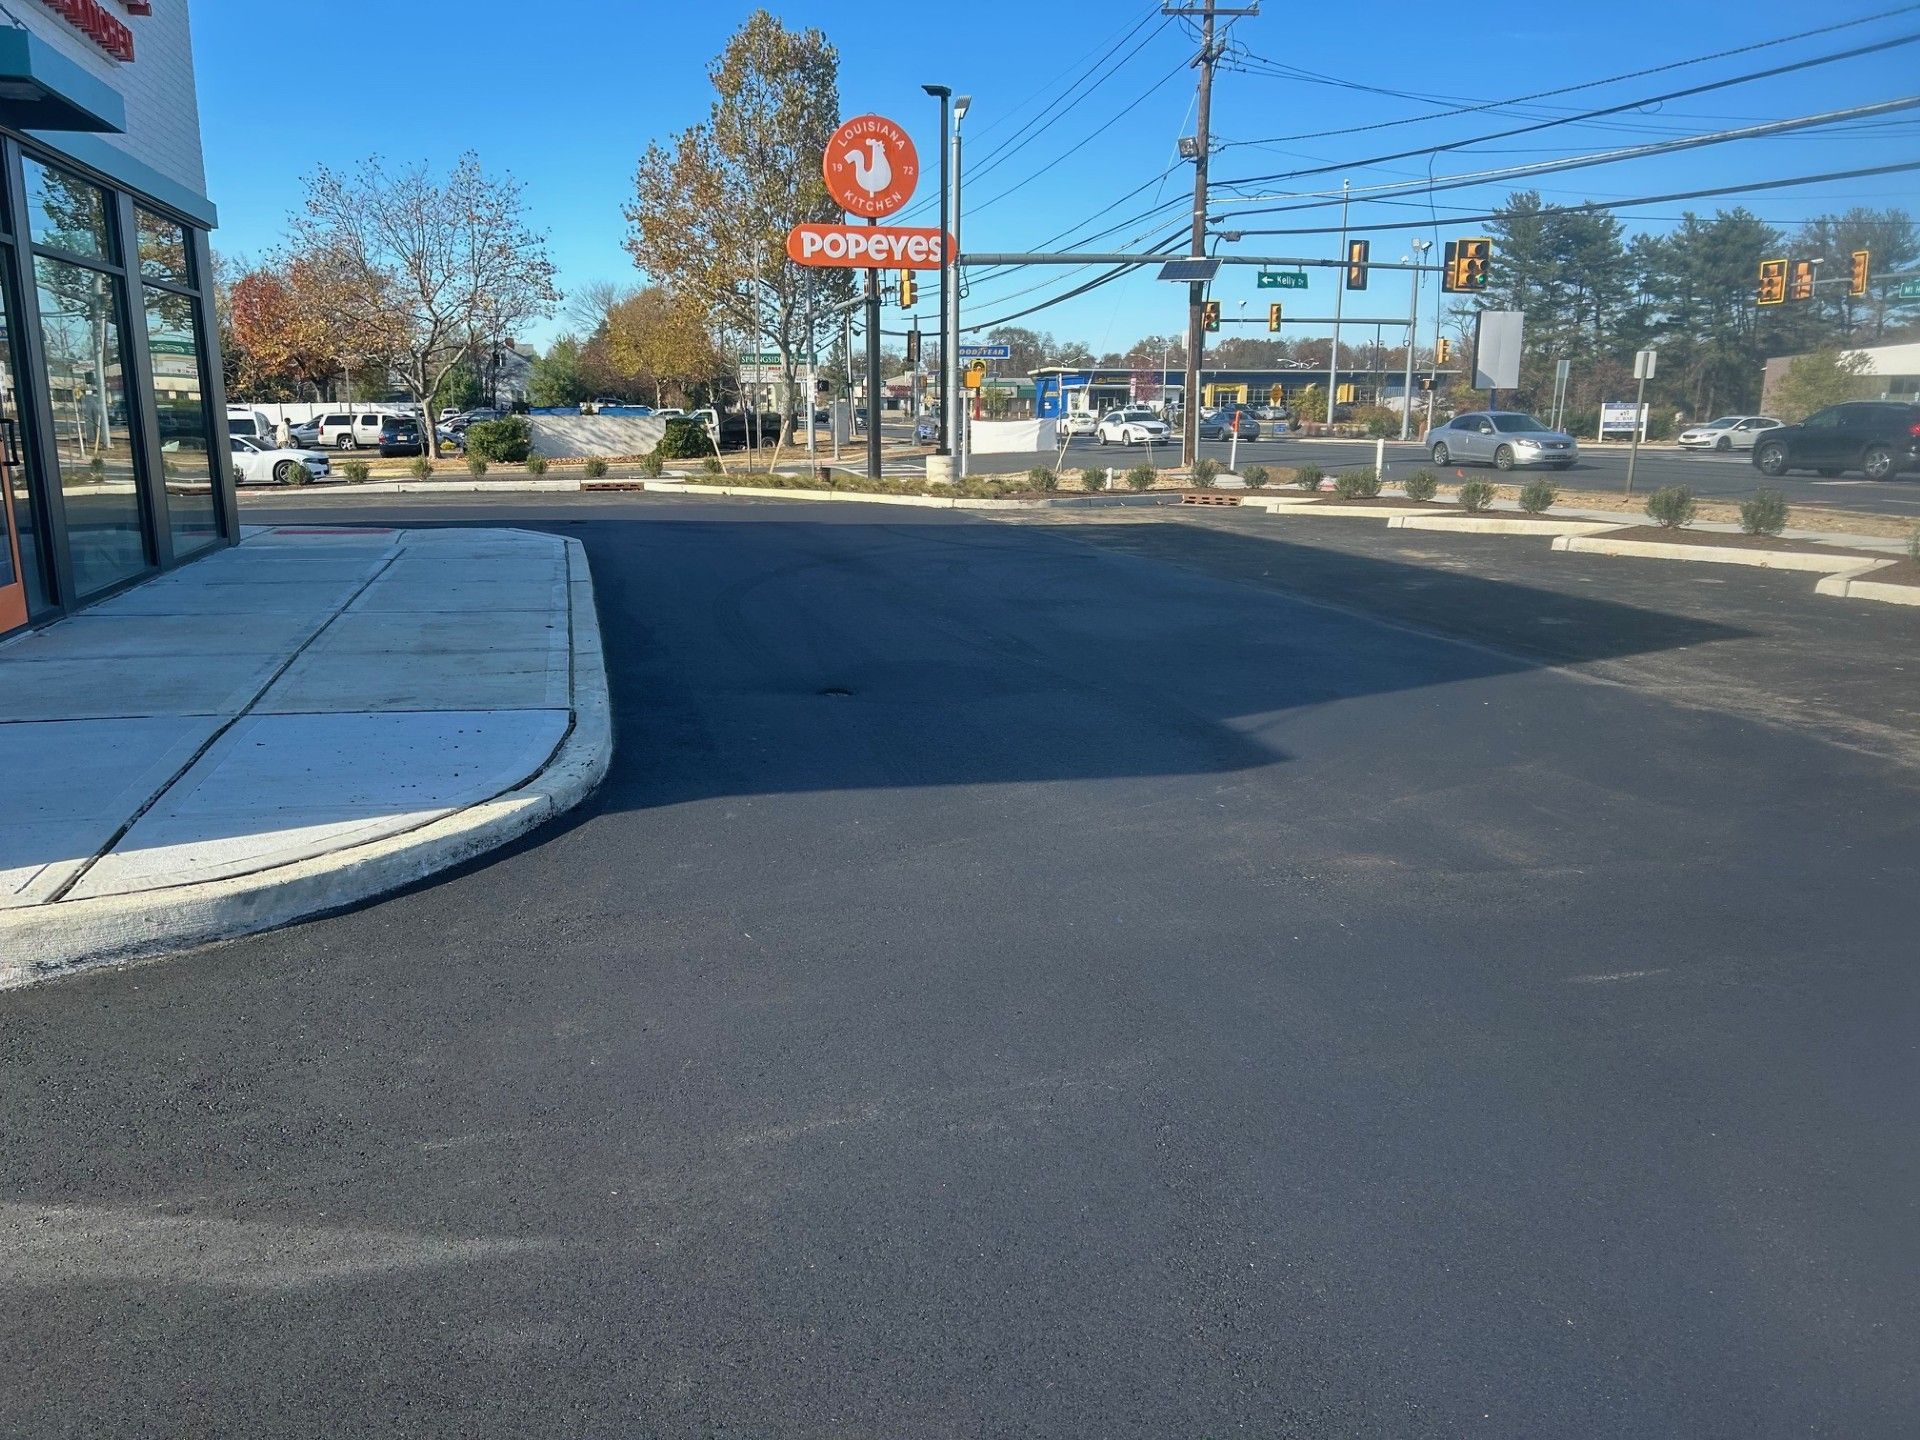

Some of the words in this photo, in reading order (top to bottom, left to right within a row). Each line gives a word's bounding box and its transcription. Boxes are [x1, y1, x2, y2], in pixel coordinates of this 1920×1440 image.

[837, 121, 905, 151] LOUISIANA
[832, 163, 843, 173] 19
[903, 165, 914, 175] 72
[844, 190, 902, 211] KITCHEN
[1277, 275, 1296, 287] Kelly
[959, 348, 1004, 356] OODYEAR
[741, 355, 781, 364] SPRINGSID
